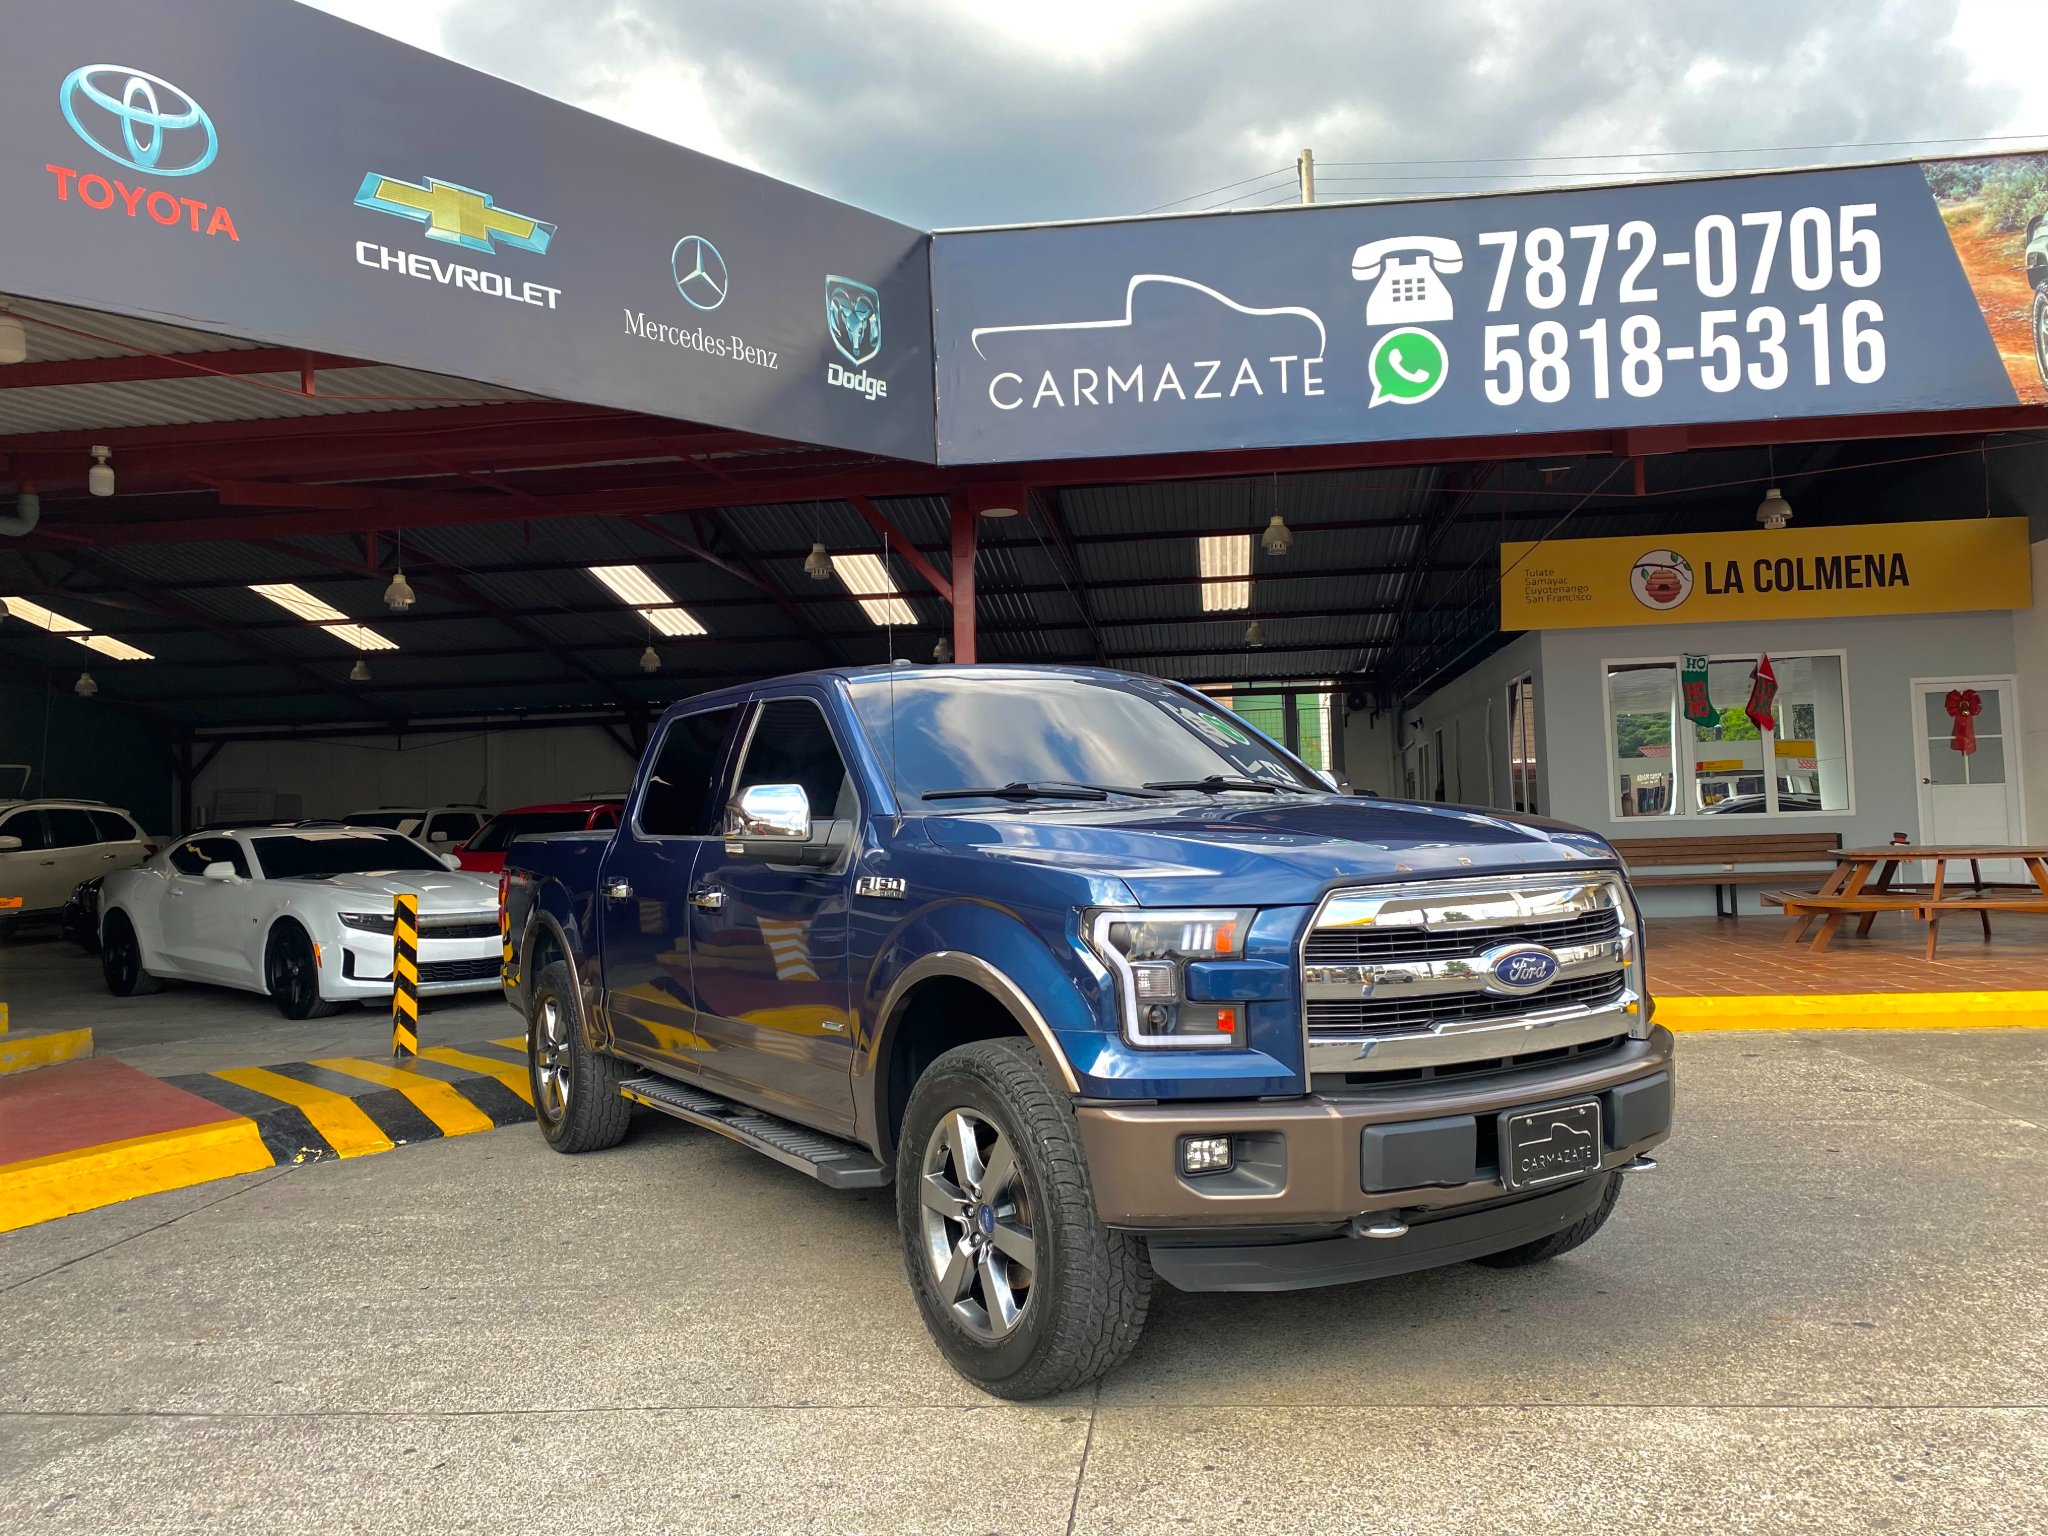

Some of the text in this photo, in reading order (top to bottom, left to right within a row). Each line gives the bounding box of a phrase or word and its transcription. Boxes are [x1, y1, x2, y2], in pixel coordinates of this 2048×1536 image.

[45, 163, 239, 242] TOYOTA
[355, 240, 562, 310] CHEVROLET
[1478, 203, 1881, 312] 7872-0705
[623, 308, 778, 370] Mercedes-Benz
[1484, 299, 1887, 406] 5818-5316
[827, 362, 887, 401] Dodge
[988, 355, 1325, 410] CARMAZATE
[1524, 568, 1554, 578] Tulate
[1524, 577, 1569, 587] Samayac
[1525, 585, 1589, 595] Cuyotenango
[1704, 552, 1910, 595] LA COLMENA
[1525, 593, 1592, 604] San Francisco
[1686, 657, 1706, 670] HO
[1509, 956, 1547, 981] Ford
[1521, 1145, 1592, 1172] CARMAZATE
